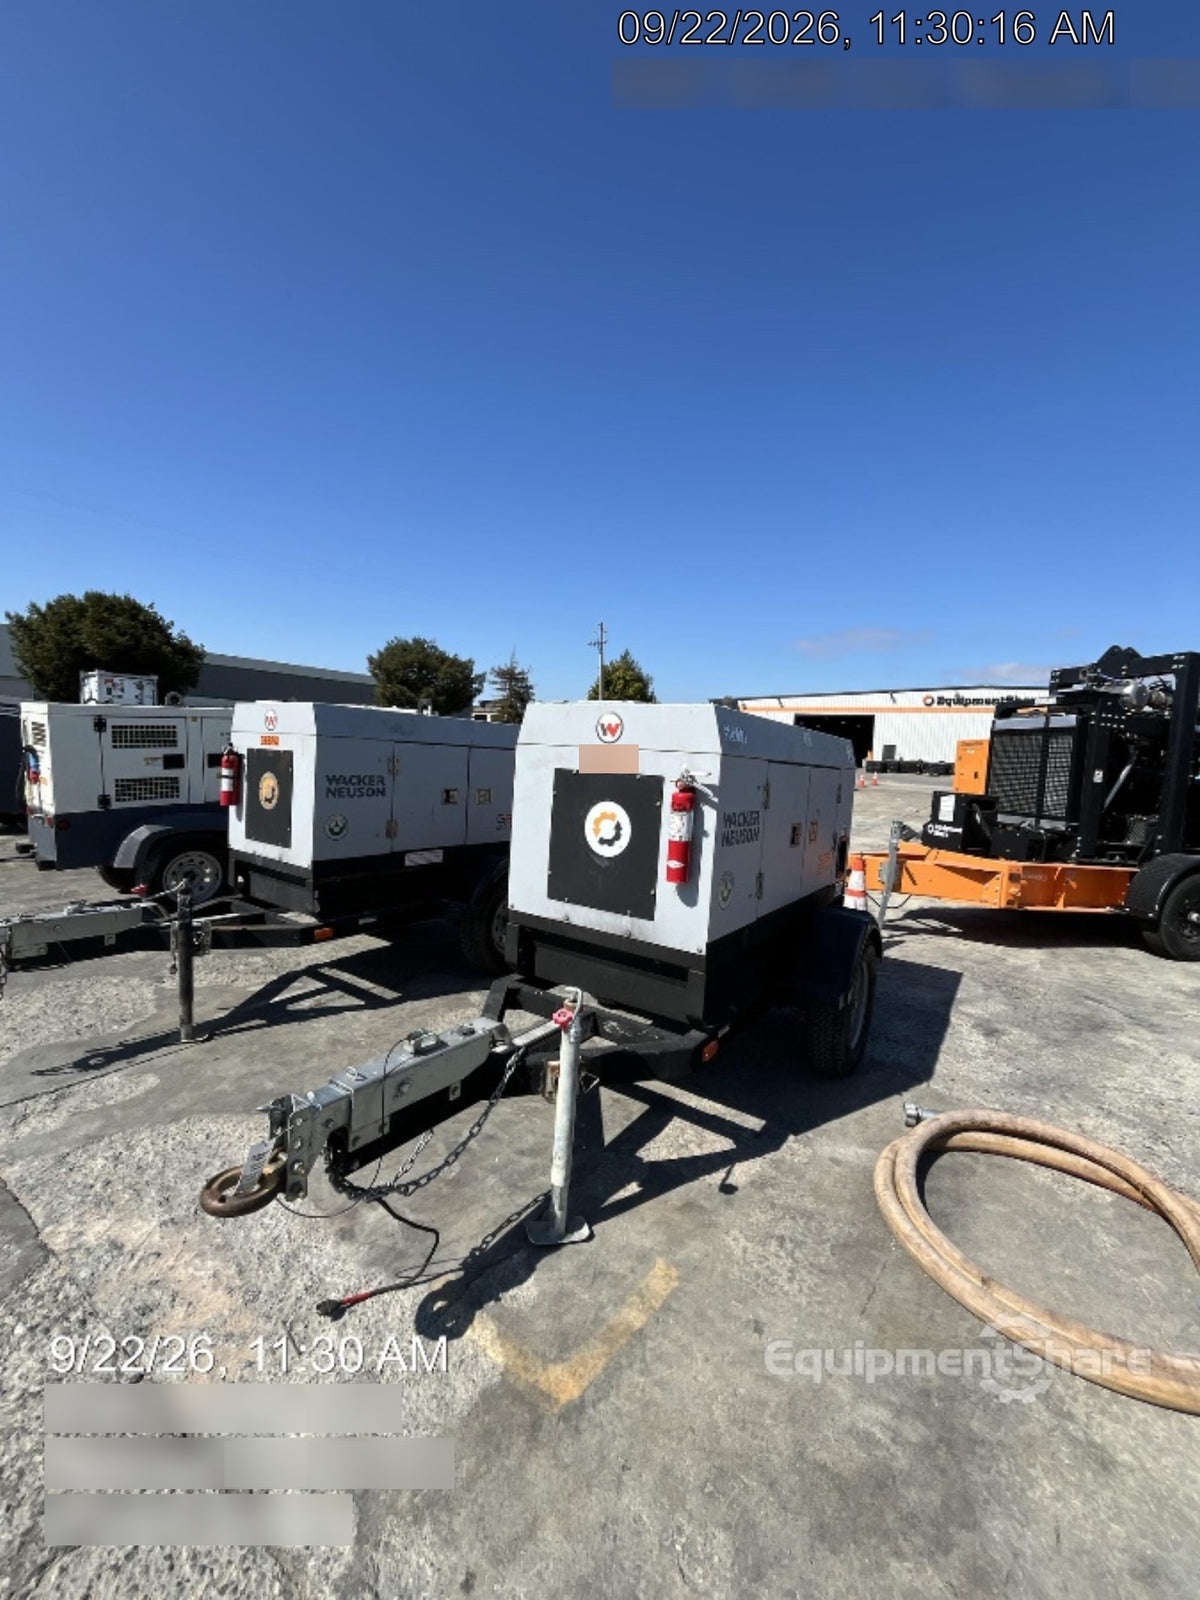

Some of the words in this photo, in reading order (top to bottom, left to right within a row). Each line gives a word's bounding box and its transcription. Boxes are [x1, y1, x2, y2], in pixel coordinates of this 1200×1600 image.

[325, 774, 386, 786] WACKER
[326, 786, 386, 799] NEUSON
[723, 810, 760, 829] WACKER
[721, 827, 760, 847] NEUSON
